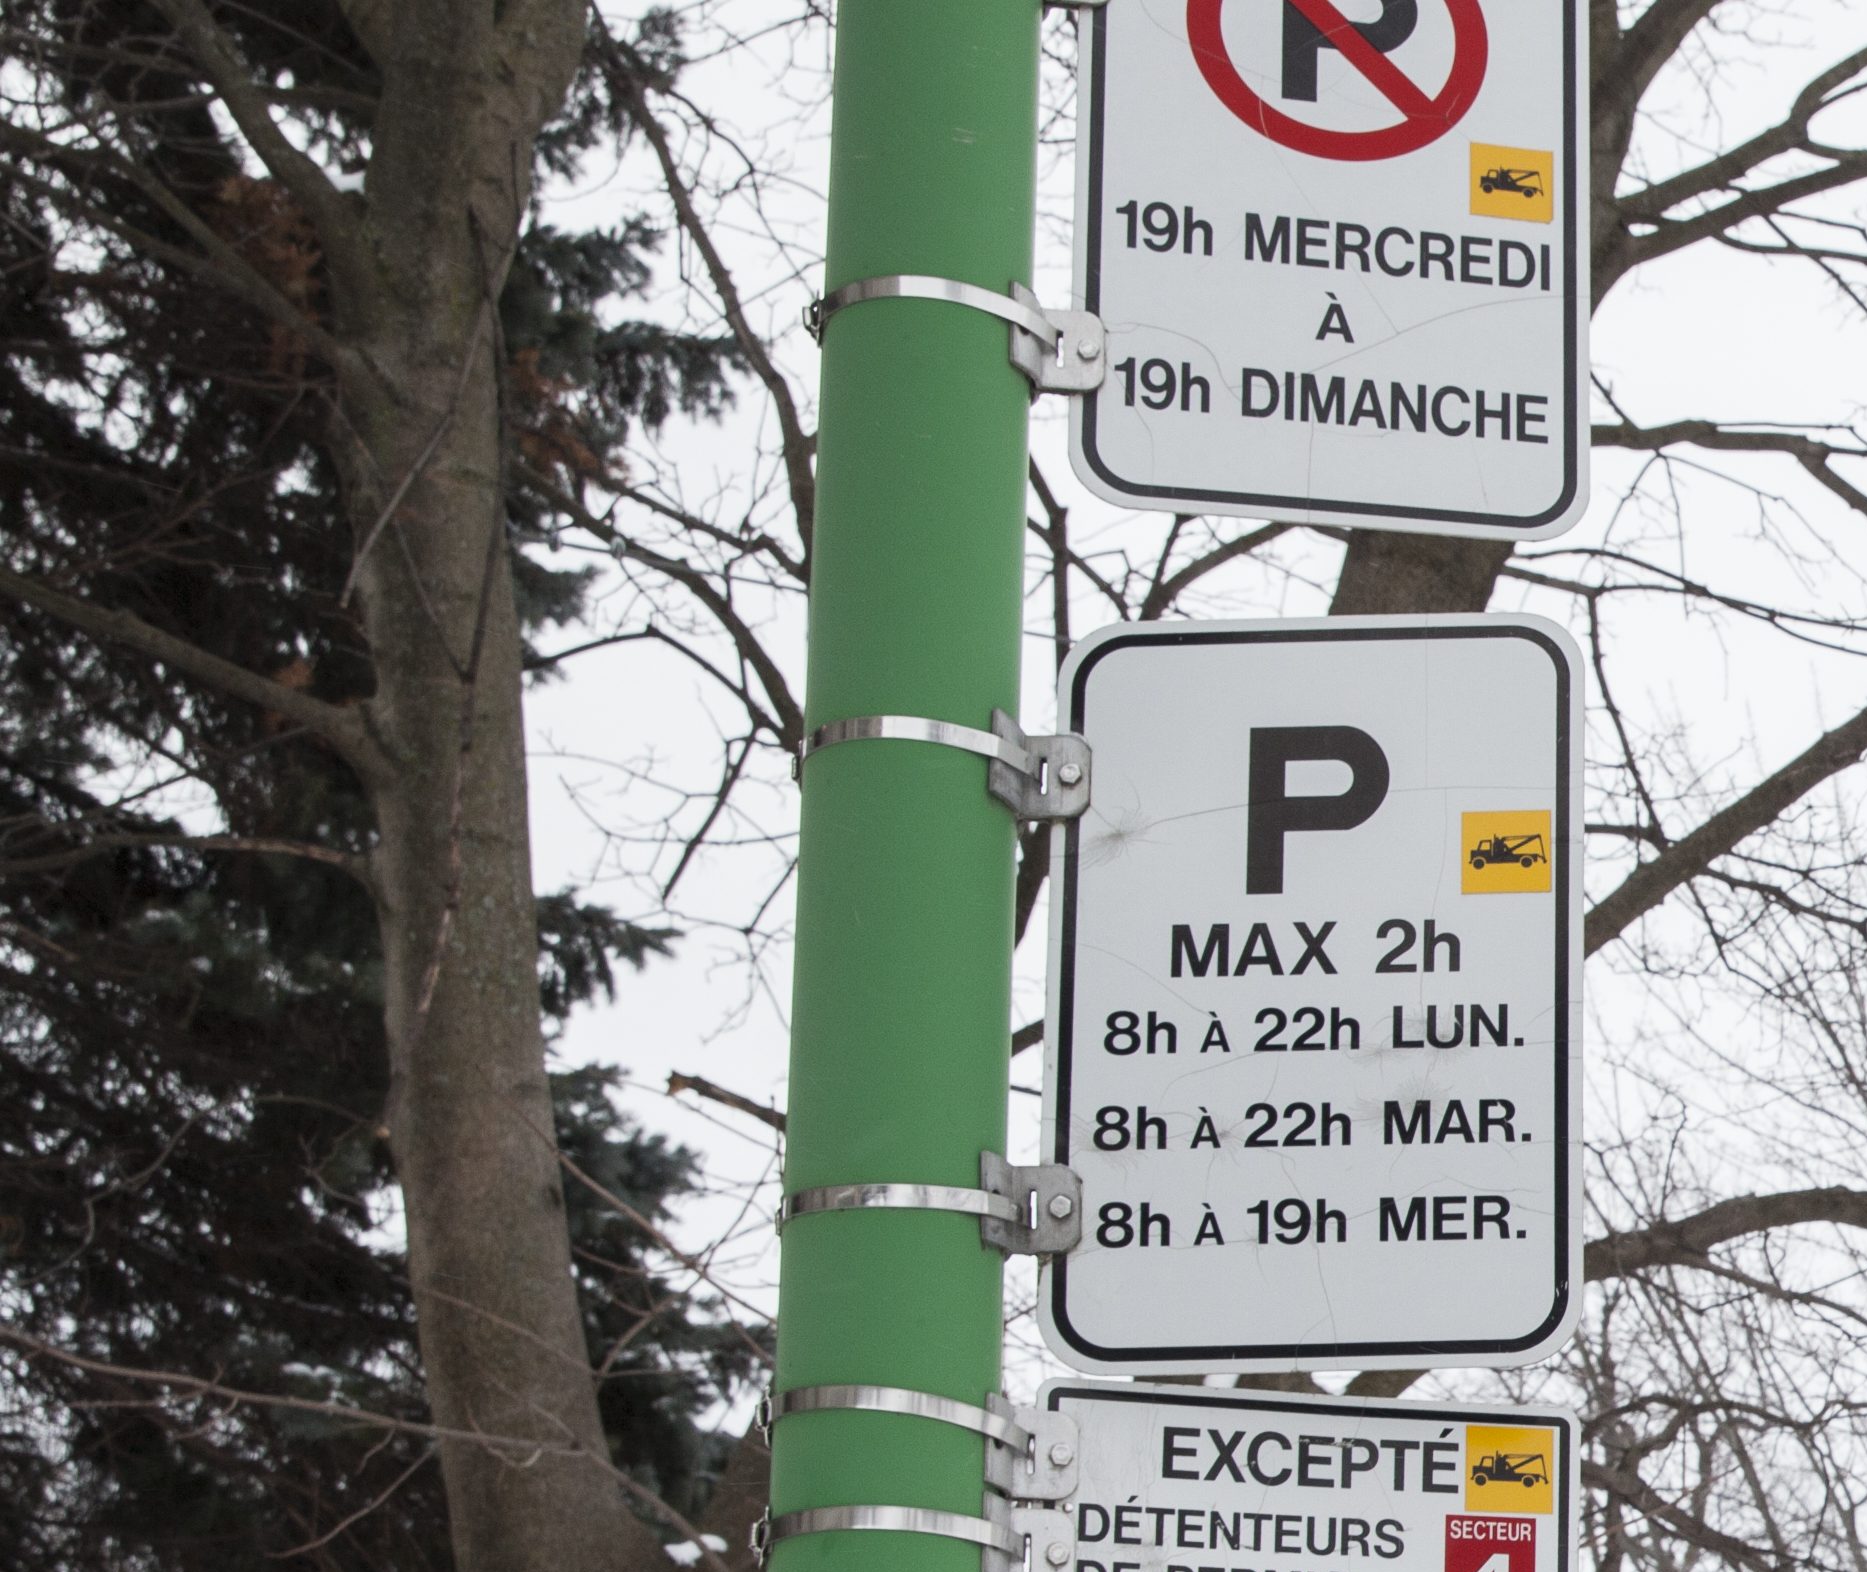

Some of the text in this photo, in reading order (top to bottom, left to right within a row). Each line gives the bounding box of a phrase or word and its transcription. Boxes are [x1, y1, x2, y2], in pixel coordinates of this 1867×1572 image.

[1115, 200, 1551, 291] 19h MERCREDI
[1315, 292, 1355, 344] À
[1114, 357, 1549, 444] 19h DIMANCHE
[1246, 725, 1390, 894] P
[1170, 919, 1461, 977] MAX 2h
[1104, 1004, 1524, 1055] 8h À 22h LUN.
[1093, 1099, 1532, 1151] 8h À 22h MAR.
[1097, 1196, 1527, 1248] 8h À 19h MER.
[1162, 1426, 1460, 1494] EXCEPTÉ
[1078, 1496, 1405, 1559] DÉTENTEURS
[1450, 1520, 1532, 1542] SECTEUR
